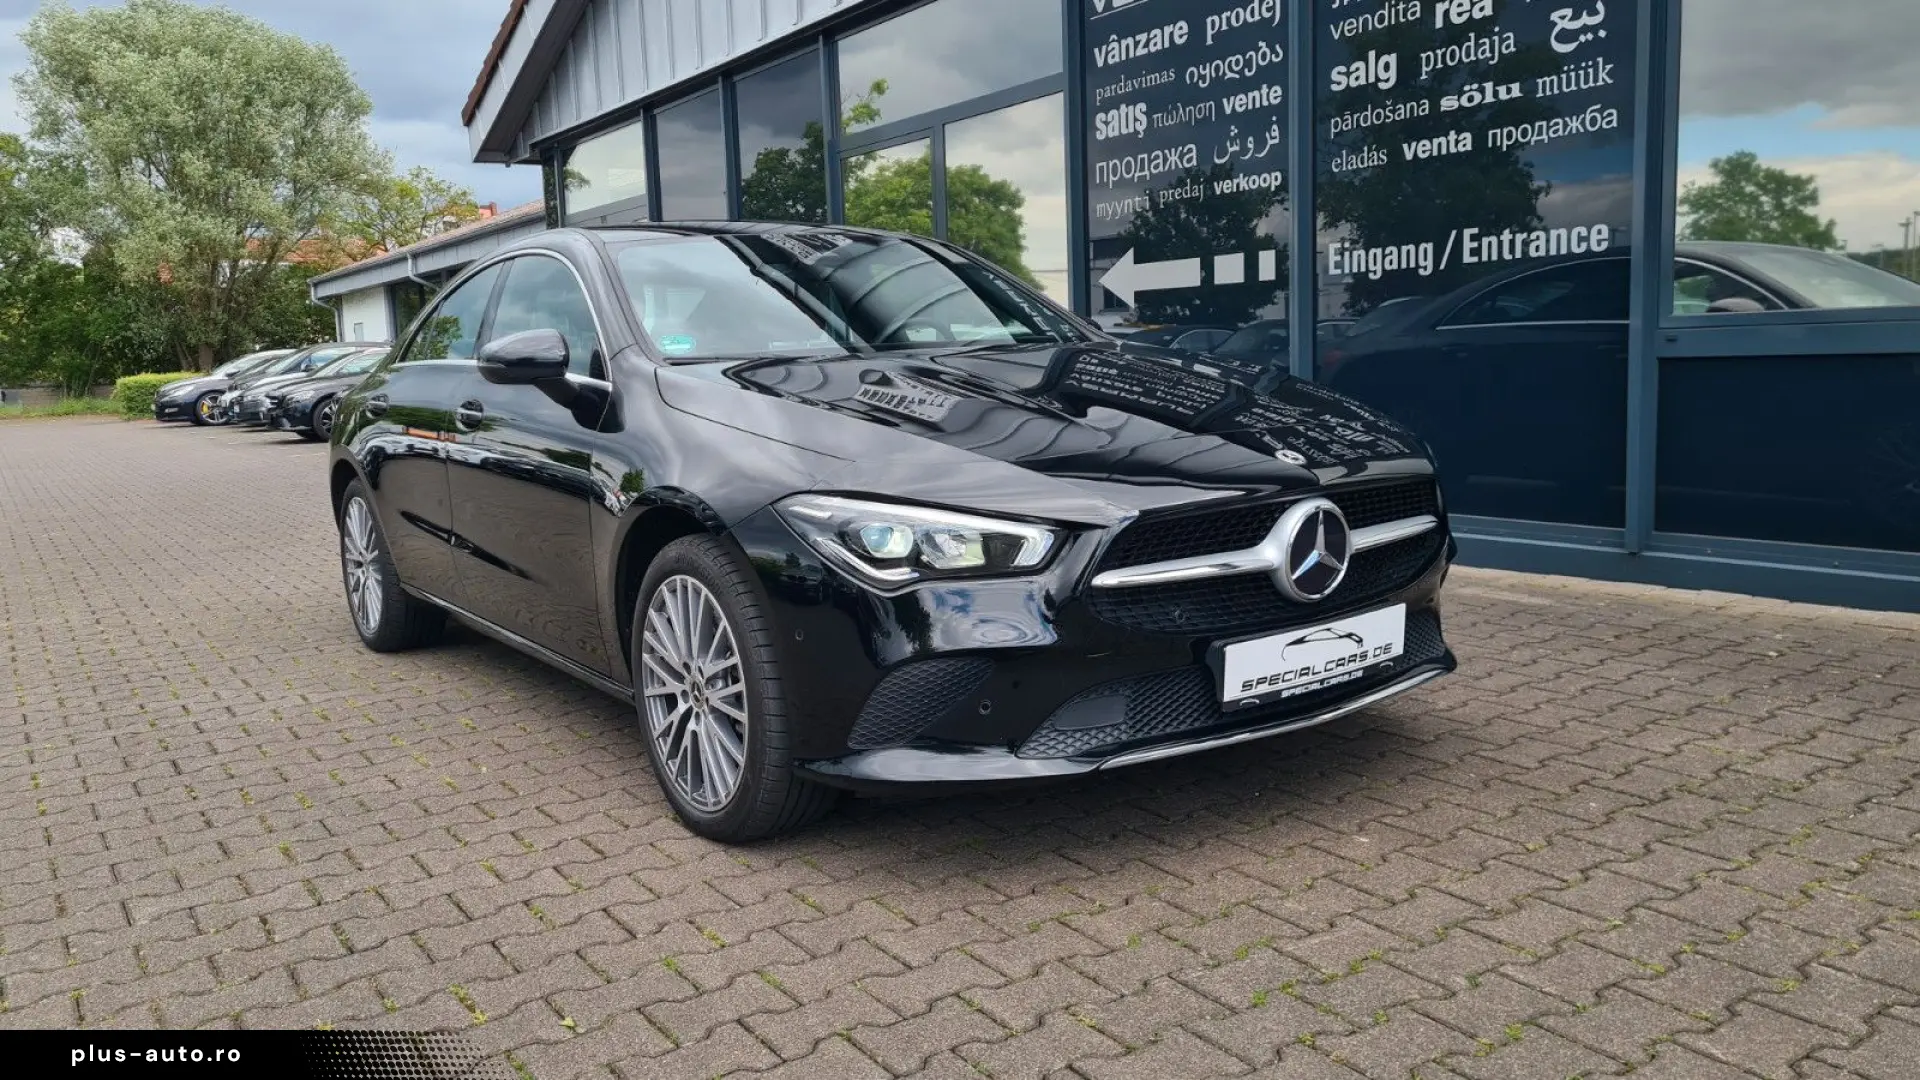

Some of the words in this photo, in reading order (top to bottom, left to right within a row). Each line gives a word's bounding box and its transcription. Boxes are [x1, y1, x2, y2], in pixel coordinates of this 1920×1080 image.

[1093, 20, 1189, 68] vânzare
[1205, 0, 1282, 46] prodej
[1330, 0, 1421, 40] vendita
[1550, 0, 1607, 54] بيع
[1330, 50, 1398, 92] salg
[1420, 26, 1516, 80] prodaja
[1095, 102, 1148, 140] satış
[1222, 84, 1283, 115] vente
[1096, 68, 1176, 106] pardavimas
[1330, 92, 1429, 139] pārdošana
[1440, 80, 1523, 112] sölu
[1535, 56, 1615, 99] müük
[1096, 143, 1198, 189] продажа
[1213, 115, 1280, 164] فروش
[1331, 145, 1388, 173] eladás
[1402, 129, 1472, 161] venta
[1488, 104, 1619, 151] продажба
[1096, 190, 1150, 221] myynti
[1159, 178, 1204, 209] predaj
[1213, 171, 1283, 196] verkoop
[1328, 240, 1433, 280] Eingang
[1462, 223, 1609, 264] Entrance
